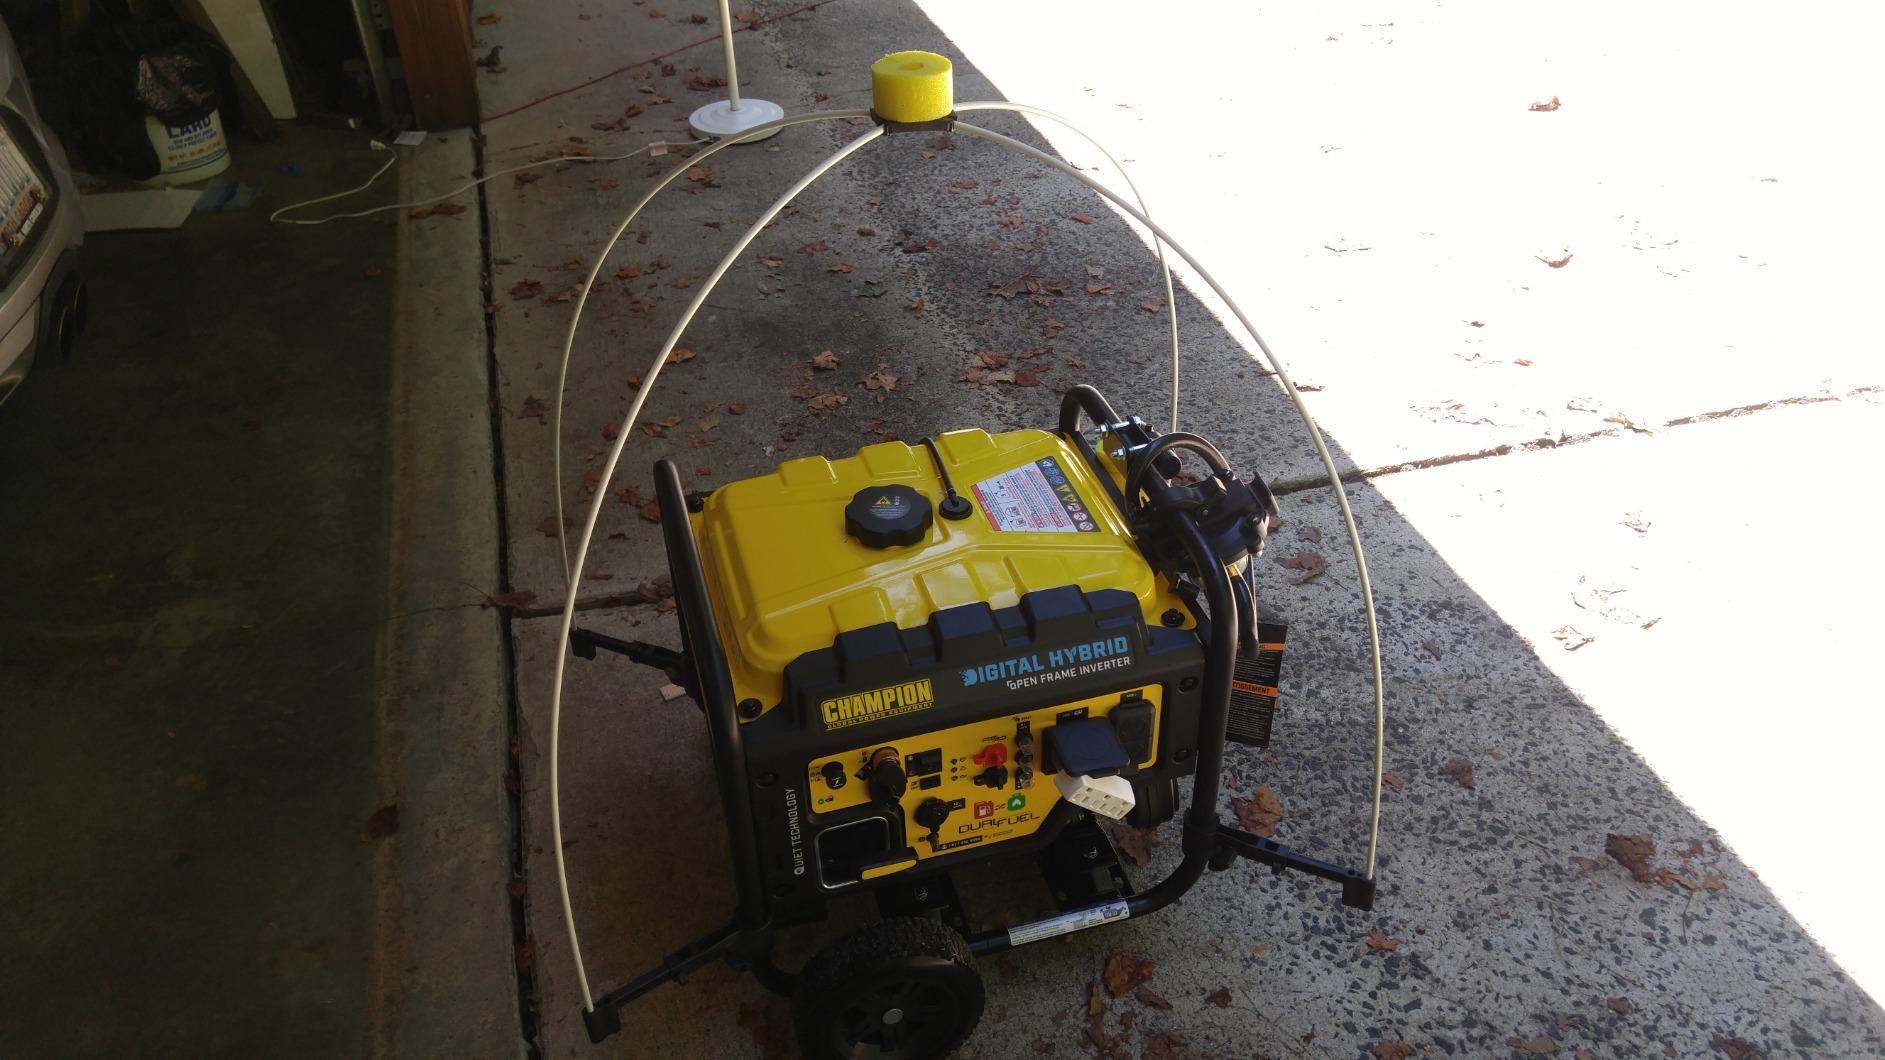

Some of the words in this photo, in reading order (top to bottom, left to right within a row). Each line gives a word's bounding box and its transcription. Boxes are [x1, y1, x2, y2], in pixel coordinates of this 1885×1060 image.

[164, 115, 211, 139] LARD
[960, 655, 1045, 687] DIGITAL
[1049, 636, 1129, 669] HYBRID
[1007, 676, 1038, 690] OPEN
[1040, 668, 1077, 684] FRAME
[1079, 656, 1131, 676] INVERTER
[823, 680, 932, 723] CHAMPION
[785, 789, 801, 847] TECHNOLOGY
[793, 848, 805, 875] QUIET
